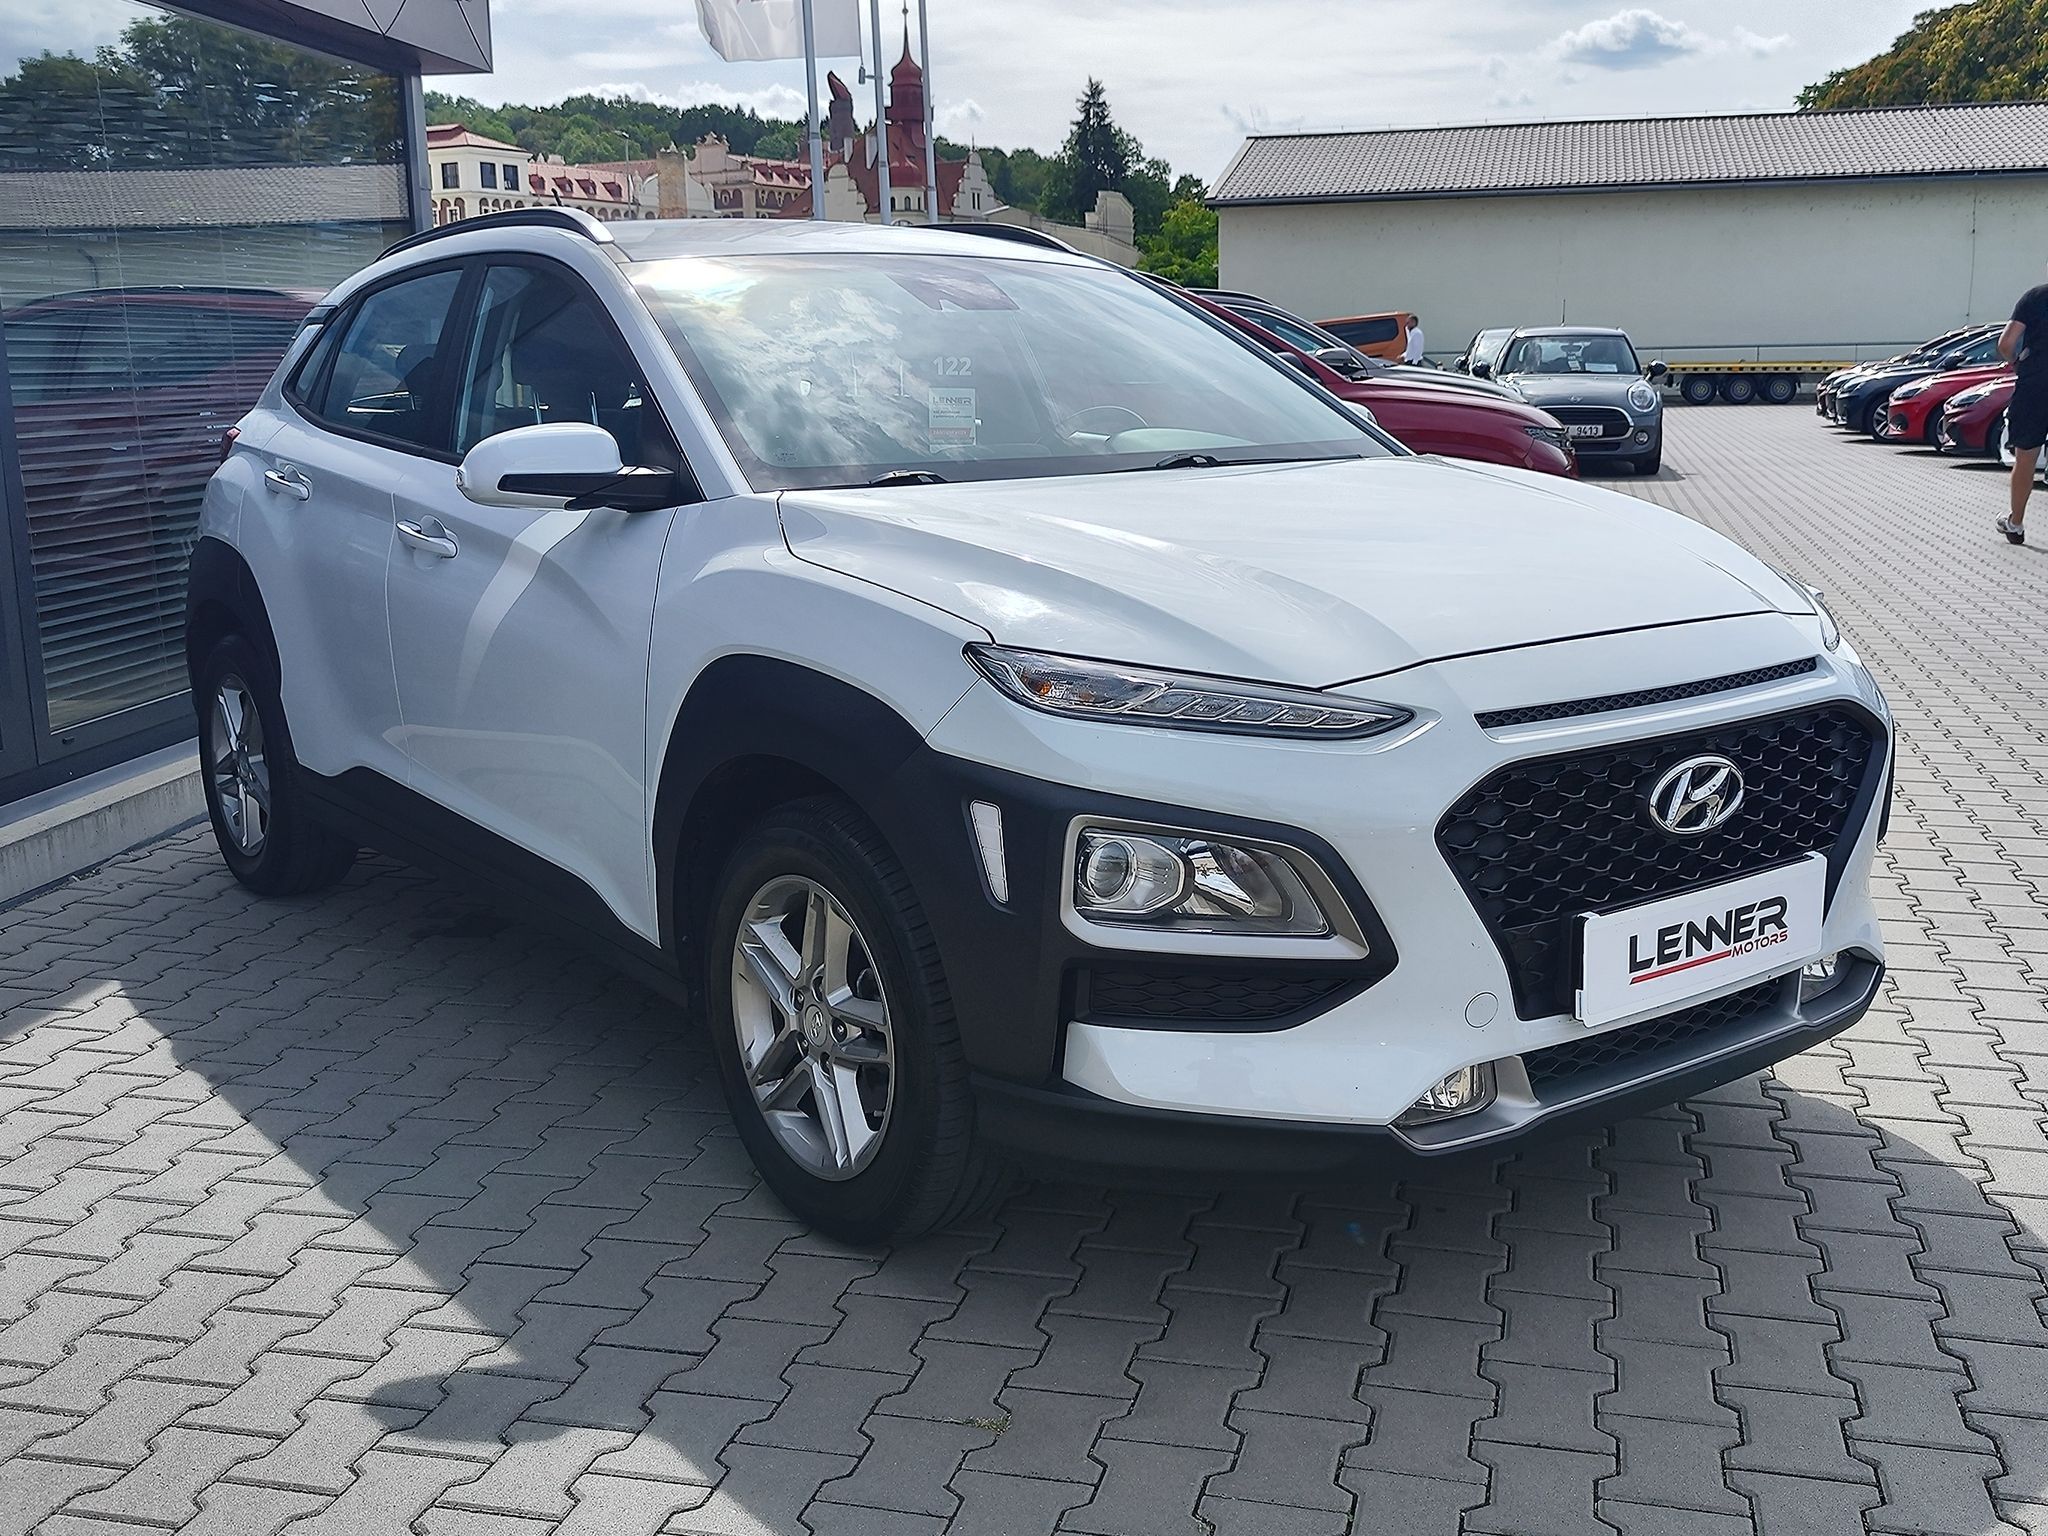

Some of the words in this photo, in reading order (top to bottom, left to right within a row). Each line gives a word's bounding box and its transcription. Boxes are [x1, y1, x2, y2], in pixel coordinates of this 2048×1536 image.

[933, 356, 972, 376] 122
[1576, 425, 1599, 436] 9413
[1629, 896, 1788, 973] LENNER
[1731, 930, 1788, 957] MOTORS
